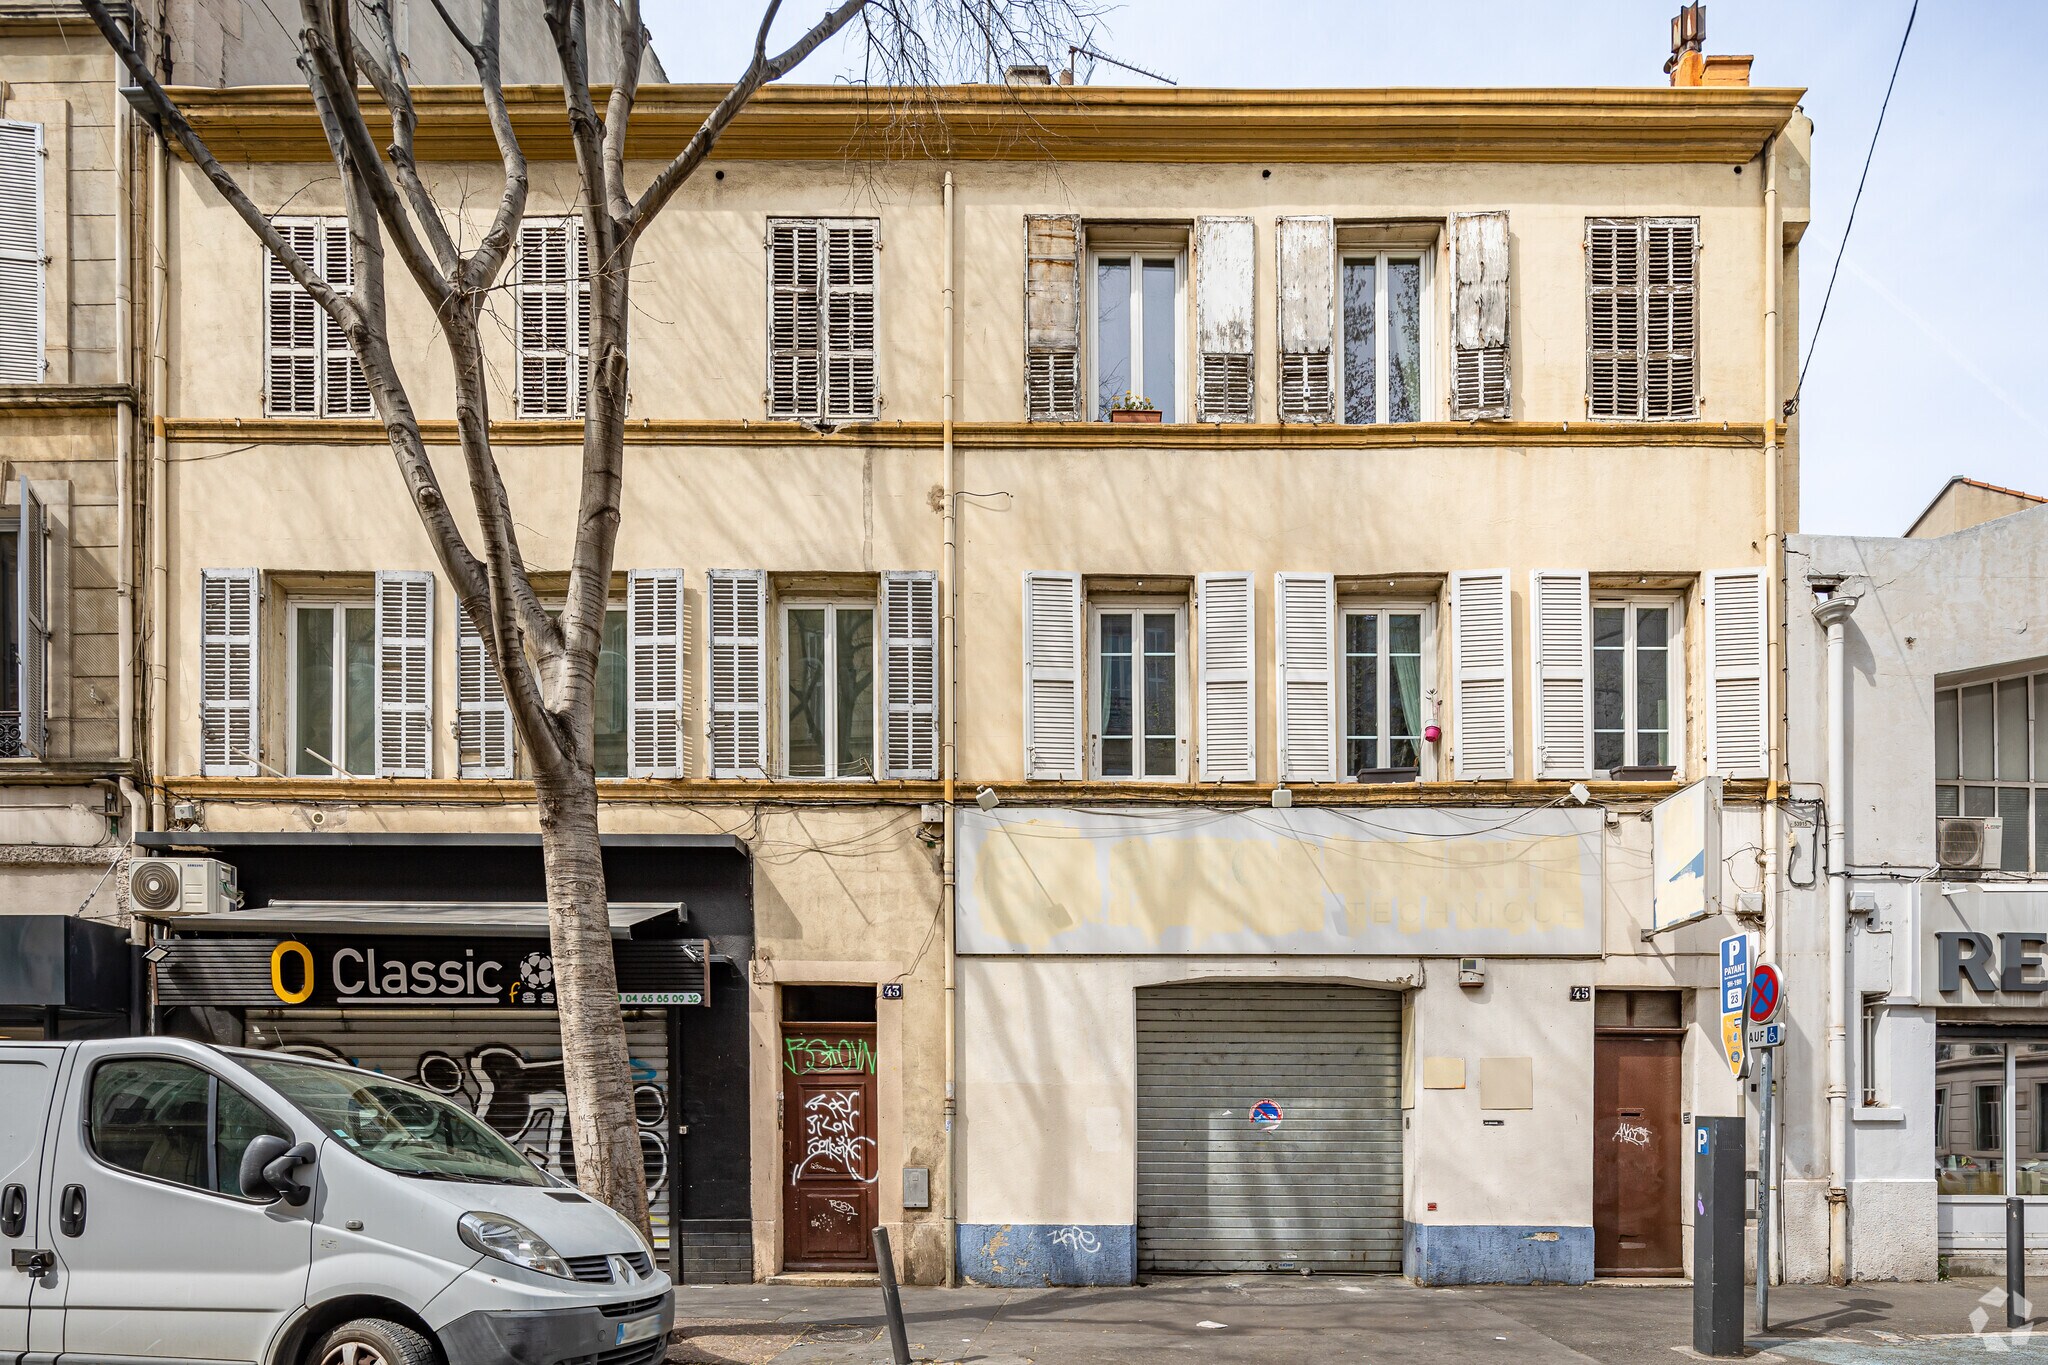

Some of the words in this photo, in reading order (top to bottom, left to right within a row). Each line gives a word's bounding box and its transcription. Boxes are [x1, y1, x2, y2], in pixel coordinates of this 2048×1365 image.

[1728, 940, 1740, 966] P
[270, 940, 314, 1005] O
[332, 947, 503, 995] Classic
[1724, 962, 1745, 977] PAYANT
[884, 985, 900, 998] 43
[1573, 987, 1589, 1000] 45
[625, 994, 638, 1003] 04
[672, 994, 685, 1003] 09
[688, 994, 699, 1003] 32
[1731, 995, 1739, 1004] 23
[1749, 1030, 1764, 1042] AUF
[1697, 1129, 1708, 1153] P
